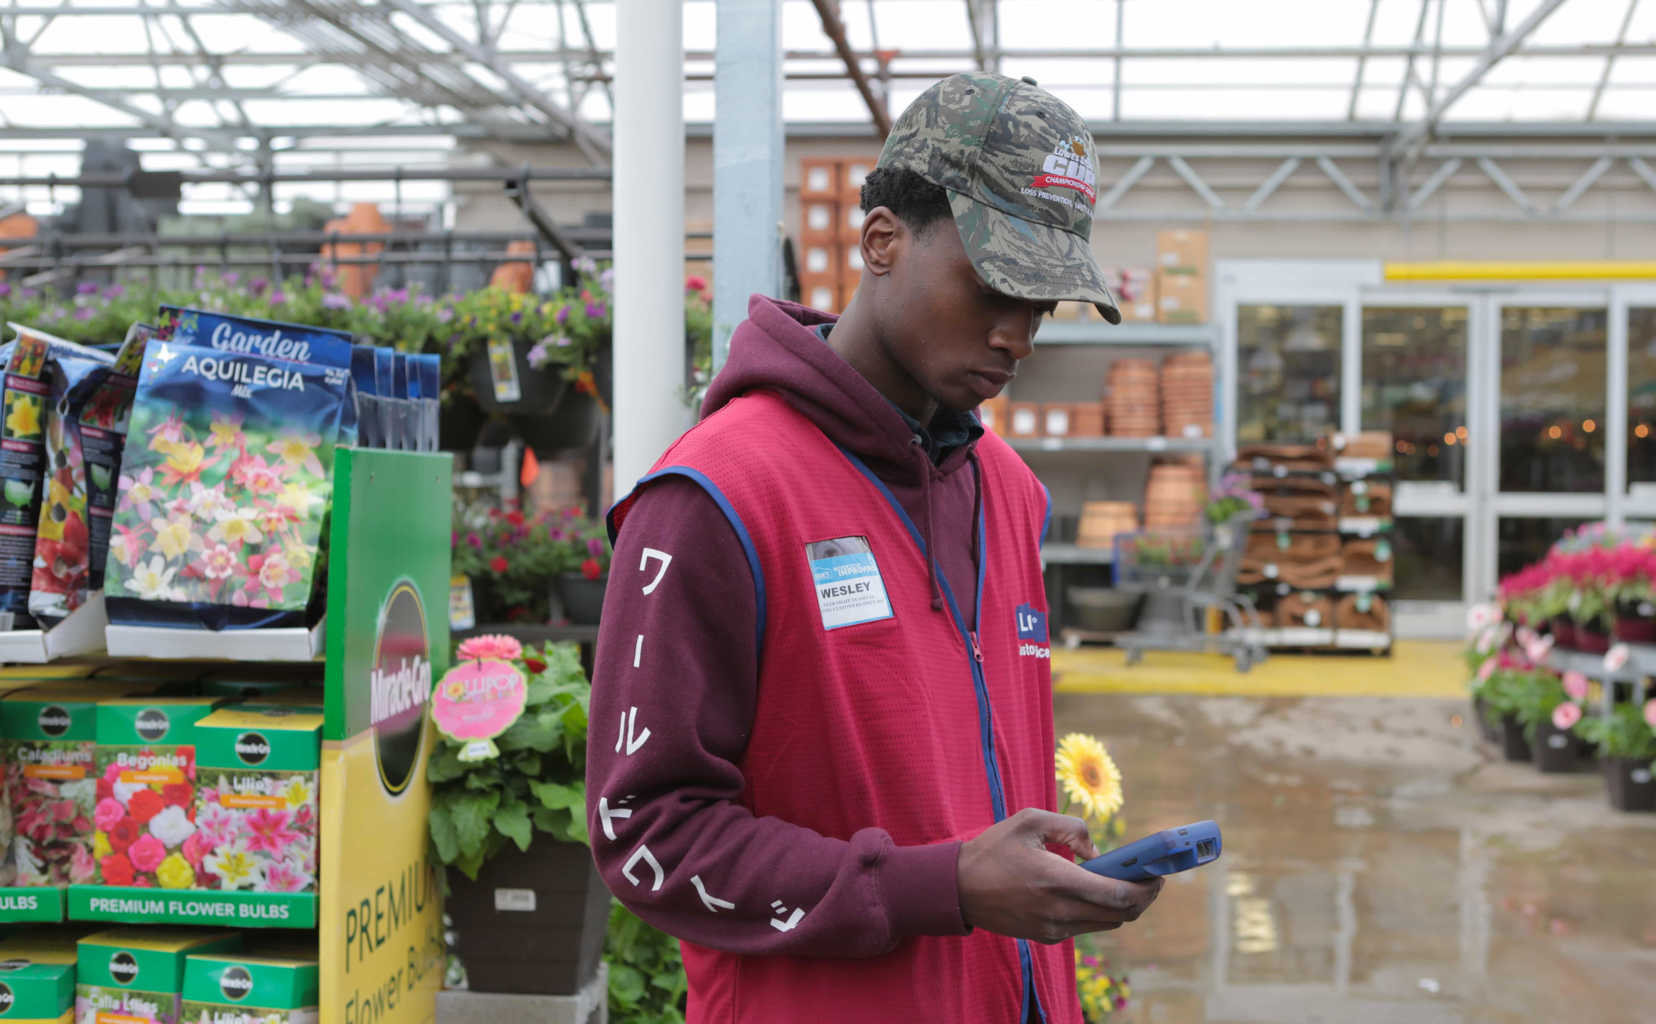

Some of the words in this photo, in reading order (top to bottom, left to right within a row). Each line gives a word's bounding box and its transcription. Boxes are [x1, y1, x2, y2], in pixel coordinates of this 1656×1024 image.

[1043, 154, 1096, 187] CUP
[1020, 187, 1037, 197] LOSS
[211, 322, 312, 363] Garden
[181, 355, 305, 392] AQUILEGIA
[230, 383, 254, 399] Mix
[820, 581, 871, 599] WESLEY
[17, 746, 93, 763] Caladiums
[117, 752, 188, 770] Begonias
[233, 775, 273, 791] Lilies
[90, 897, 165, 915] PREMIUM
[168, 901, 236, 917] FLOWER
[239, 903, 290, 919] BULBS
[89, 994, 120, 1011] Calla
